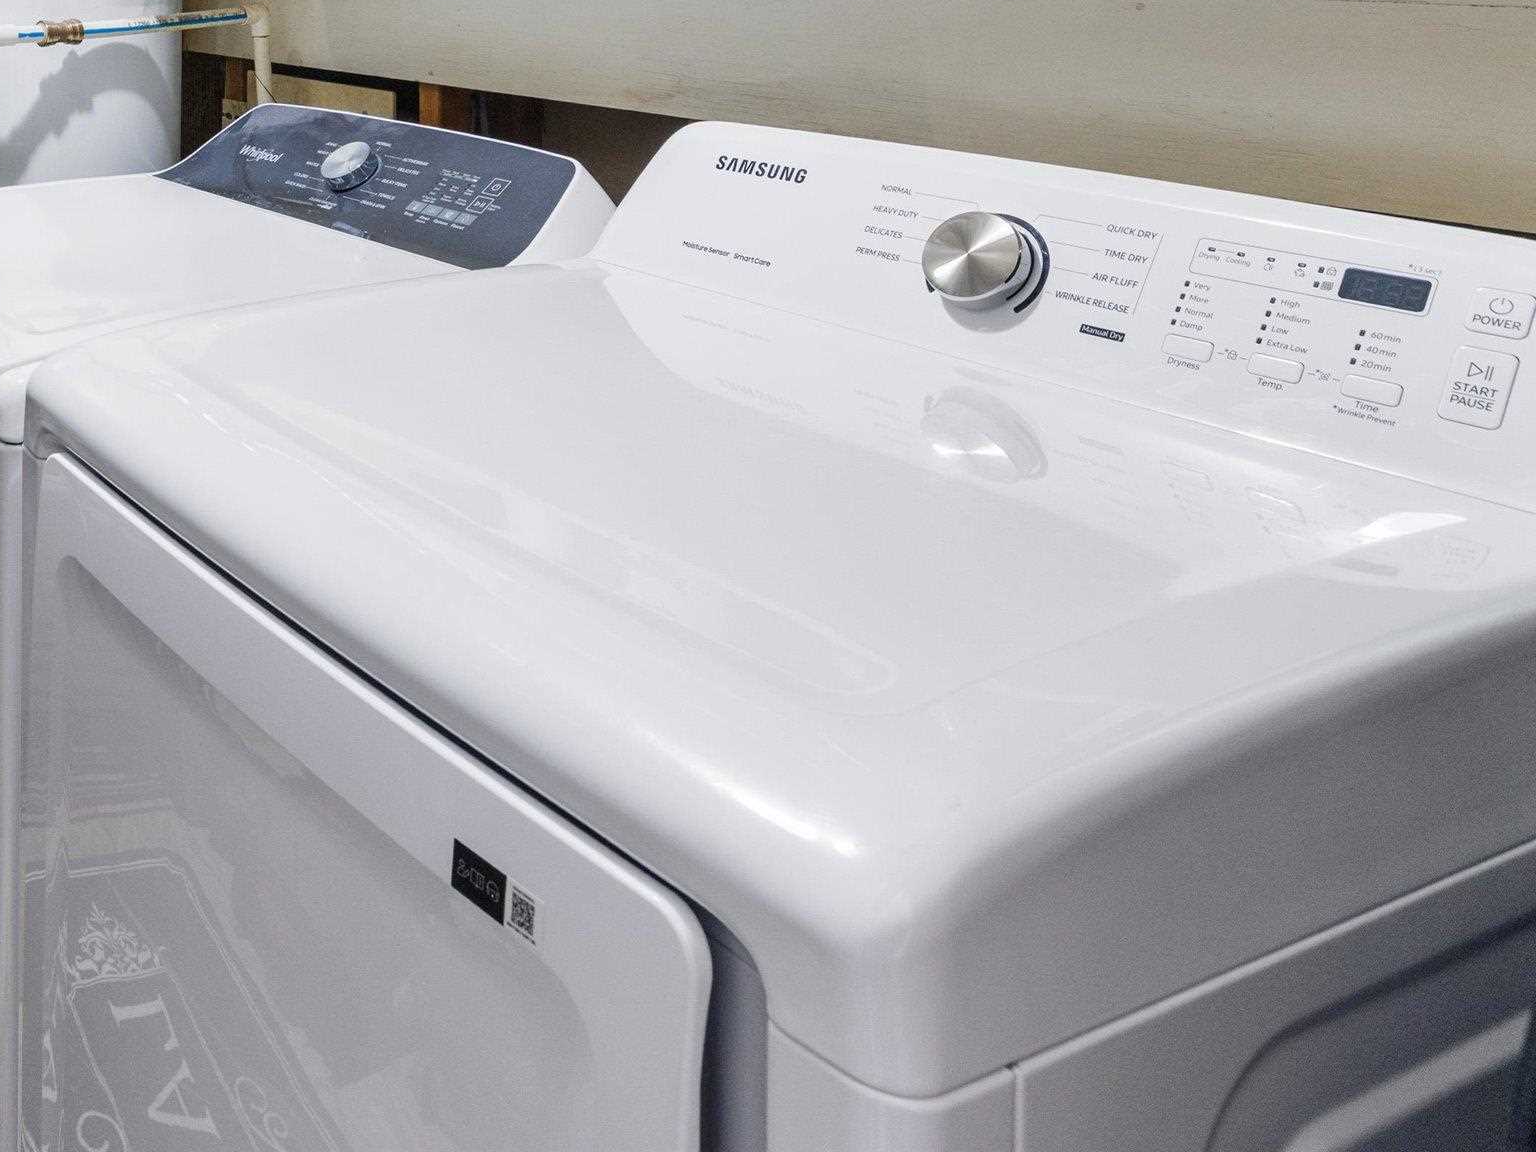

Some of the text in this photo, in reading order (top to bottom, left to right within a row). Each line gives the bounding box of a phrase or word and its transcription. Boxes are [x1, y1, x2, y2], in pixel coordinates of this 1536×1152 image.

[239, 144, 284, 163] Whirlpool
[715, 155, 808, 184] SAMSUNG
[881, 184, 913, 195] NORMAL
[872, 205, 919, 219] HEAVY DUTY
[864, 225, 904, 239] DELICATES
[1106, 223, 1159, 241] QUICK DRY
[682, 240, 709, 252] Moisture
[708, 246, 731, 257] Sensor
[856, 246, 901, 262] PERM PRESS
[1105, 248, 1149, 264] TIME DRY
[1224, 257, 1251, 268] Cooling
[1091, 272, 1140, 289] AIR FLUFF
[1193, 281, 1210, 292] Very
[1055, 290, 1131, 314] WRINKLE RELEASE
[1189, 293, 1210, 304] More
[1281, 299, 1301, 309] High
[1184, 307, 1214, 320] Normal
[1275, 311, 1311, 326] Medium
[1179, 320, 1203, 332] Damp
[1472, 313, 1522, 331] POWER
[1081, 324, 1125, 342] Manual Dry
[1271, 325, 1289, 335] Low
[1266, 338, 1309, 354] Extra Low
[1166, 356, 1201, 371] Dryness
[1258, 377, 1284, 391] Temp.
[1452, 381, 1500, 398] START
[1354, 400, 1380, 413] Time
[1449, 393, 1495, 412] PAUSE
[1366, 412, 1397, 428] Prevent
